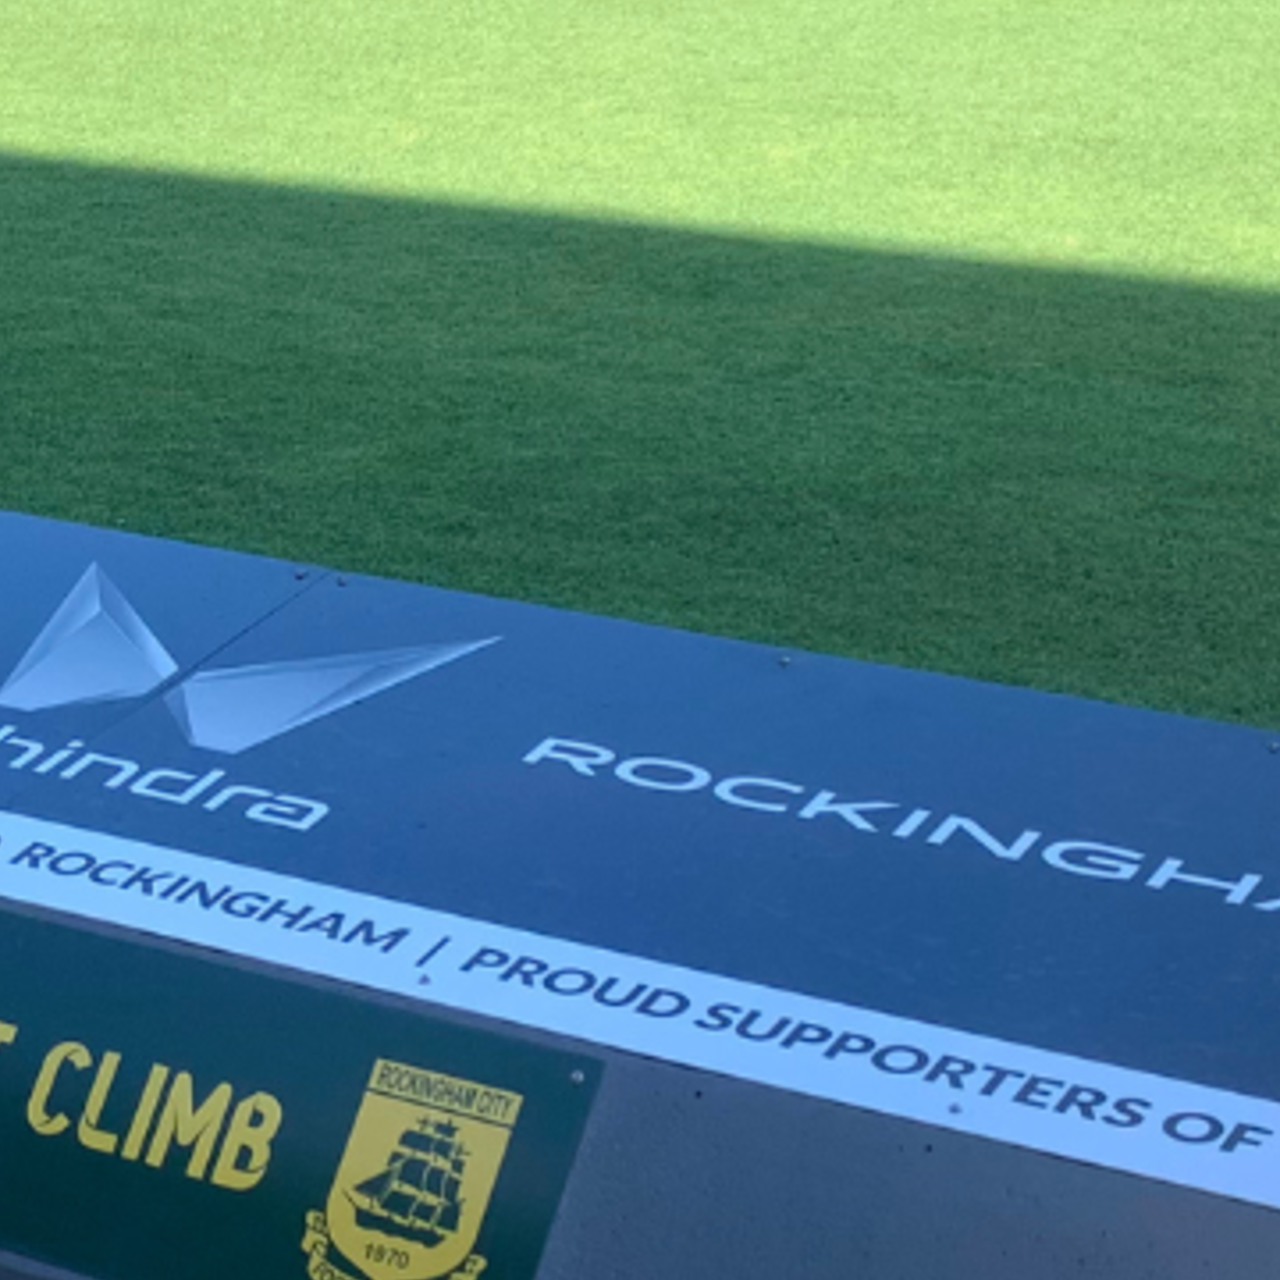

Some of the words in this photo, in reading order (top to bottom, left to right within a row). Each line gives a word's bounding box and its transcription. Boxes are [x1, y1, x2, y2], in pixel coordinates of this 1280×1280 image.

[10, 839, 409, 955] ROCKINGHAM
[459, 947, 693, 1021] PROUD
[697, 1003, 1154, 1130] SUPPORTERS
[1160, 1111, 1274, 1157] OF
[26, 1041, 283, 1191] CLIMB
[376, 1063, 477, 1112] ROCKINGHAM
[476, 1088, 515, 1119] CITY
[364, 1243, 410, 1270] 1970
